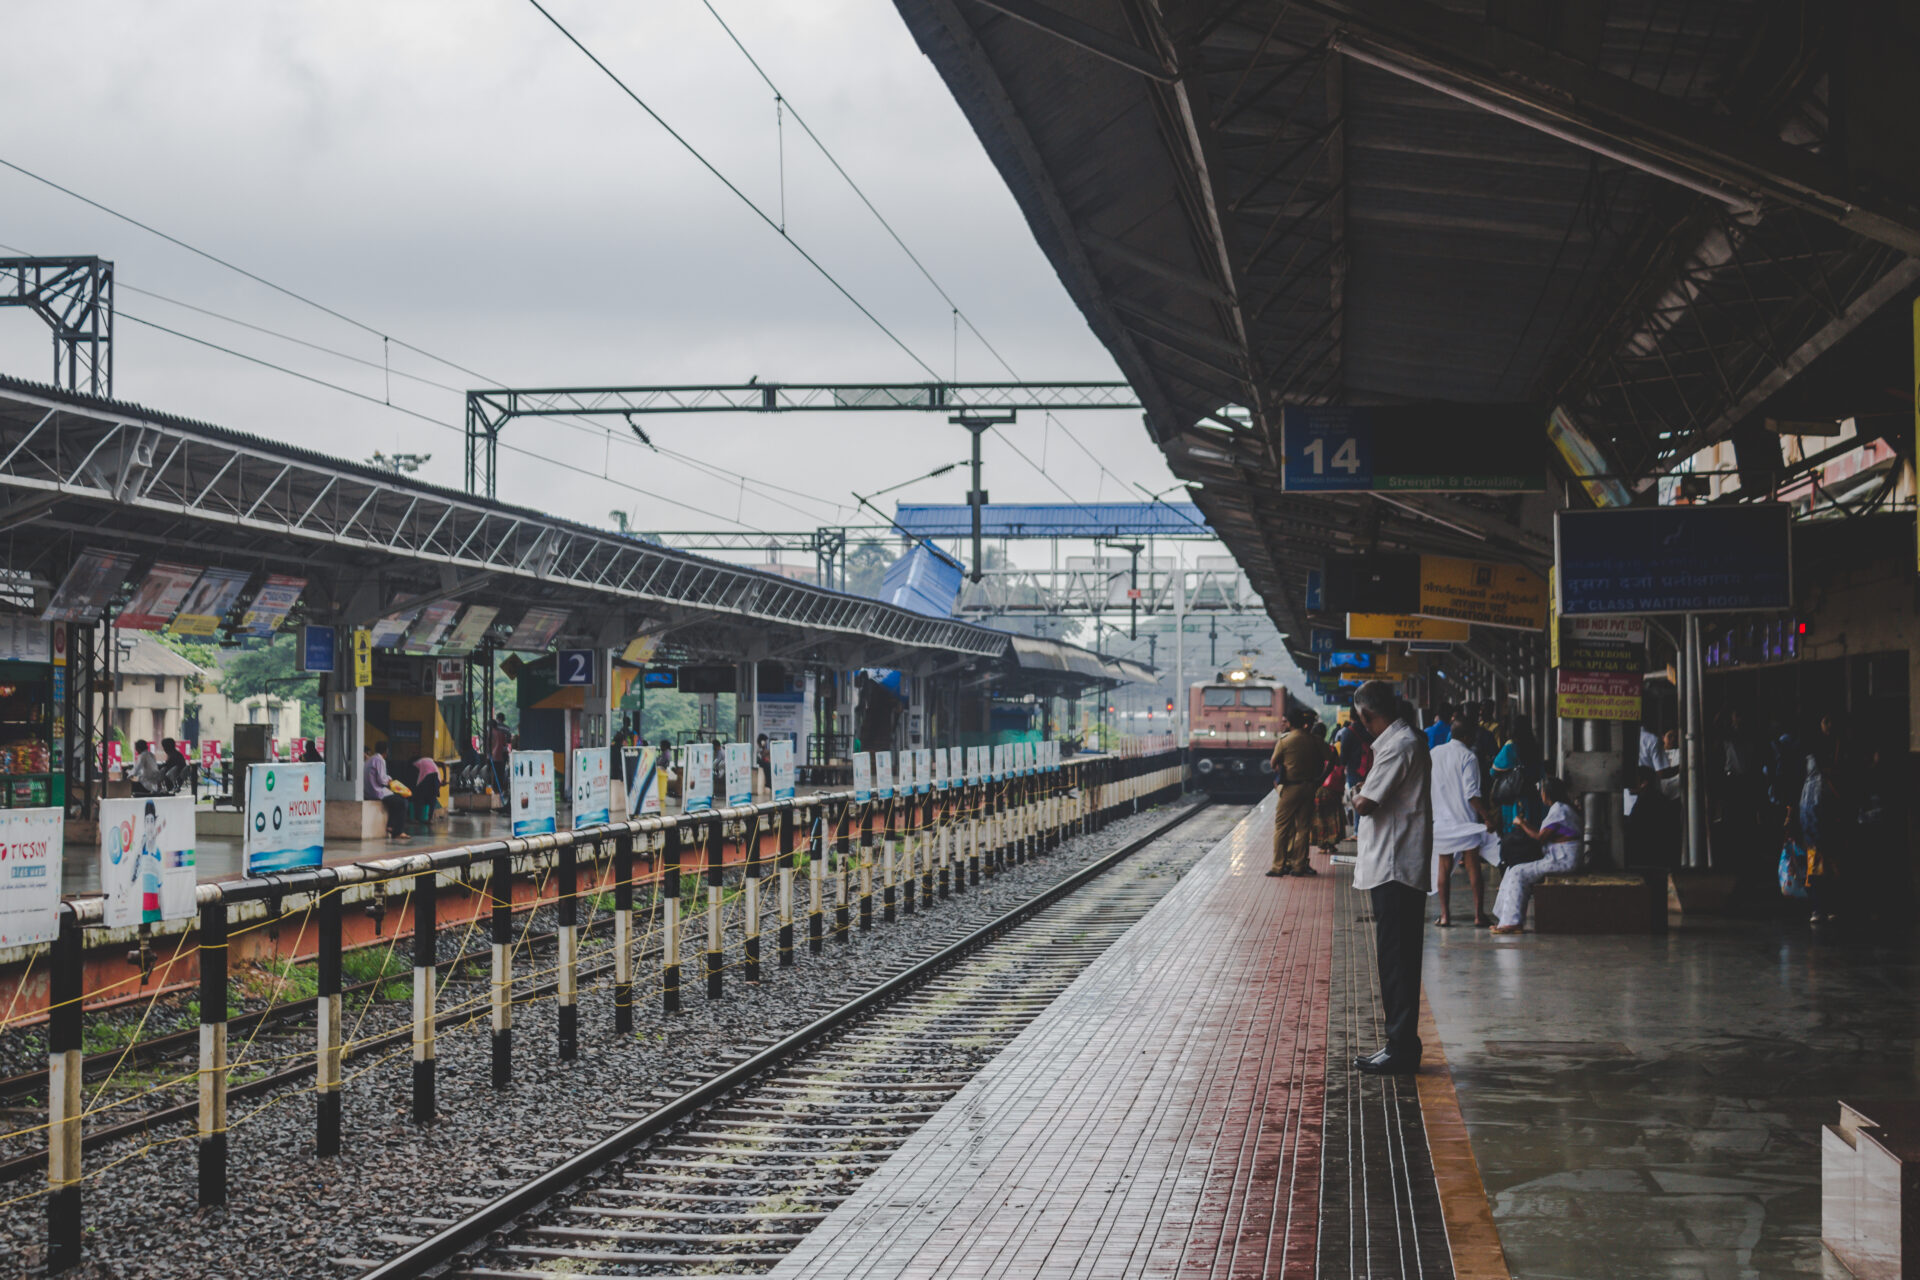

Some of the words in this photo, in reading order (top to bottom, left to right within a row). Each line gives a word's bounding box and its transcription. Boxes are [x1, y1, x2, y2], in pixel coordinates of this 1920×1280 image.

[1304, 438, 1360, 474] 14
[1389, 476, 1445, 489] Strength
[1449, 477, 1459, 486] &
[1463, 476, 1525, 488] Durability
[1588, 598, 1635, 611] CLASS
[1639, 596, 1703, 609] WAITING
[1707, 595, 1751, 607] ROOM
[1422, 605, 1491, 621] RESERVATION
[1494, 613, 1534, 627] CHARTS
[1394, 630, 1423, 639] EXIT
[1317, 638, 1333, 649] 16
[569, 653, 586, 682] 2
[289, 800, 322, 816] HYCOUNT
